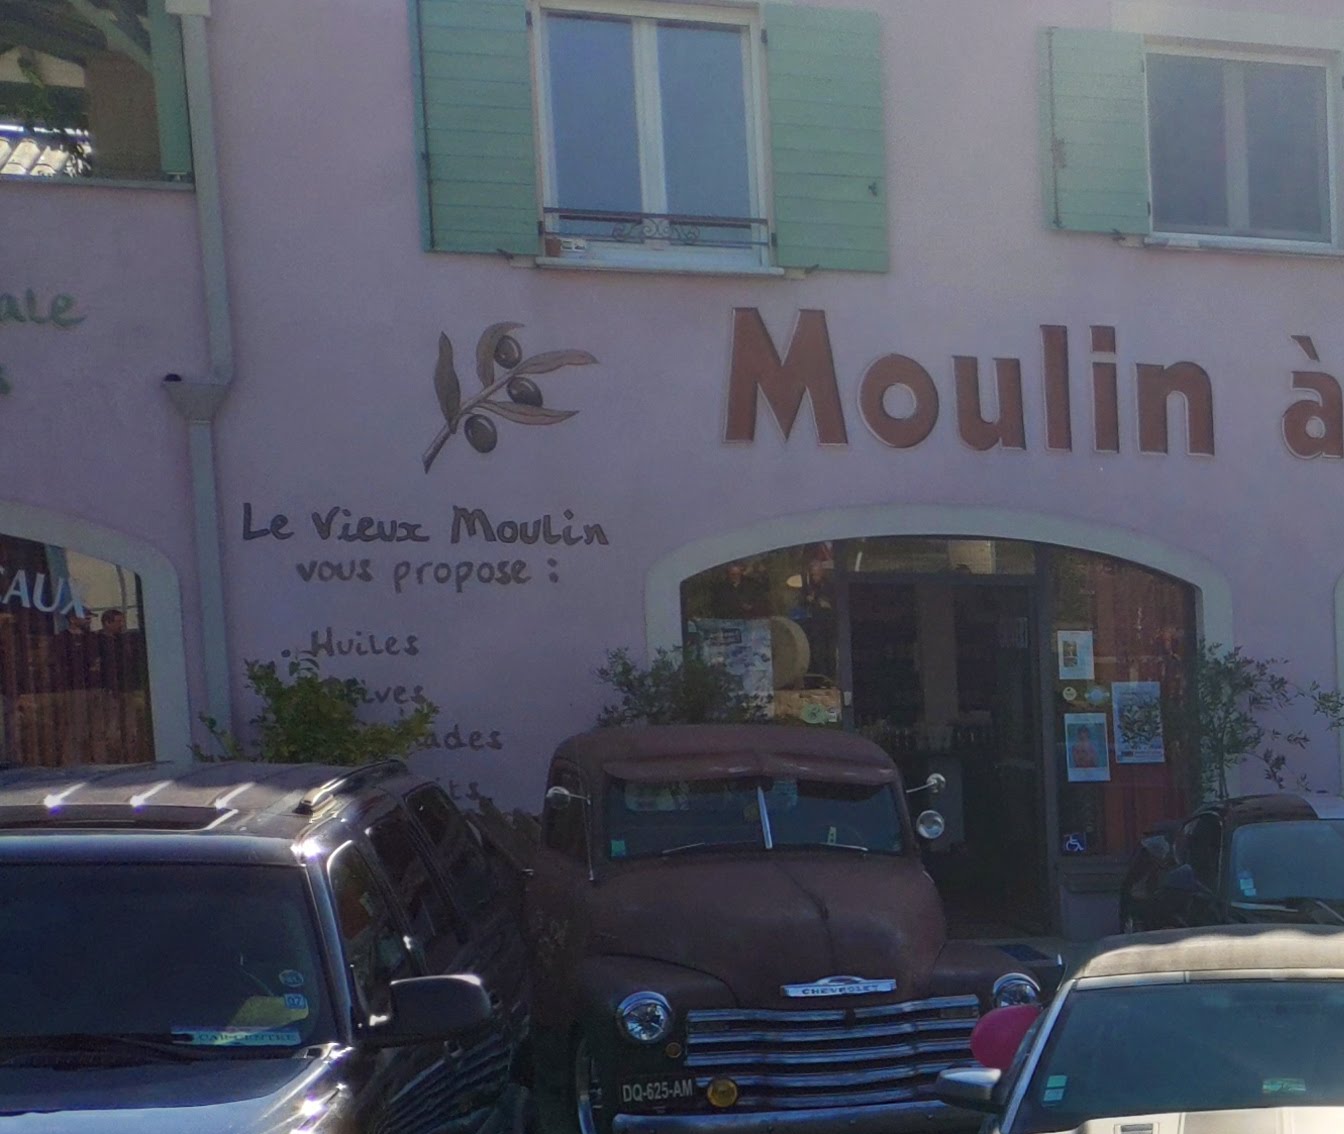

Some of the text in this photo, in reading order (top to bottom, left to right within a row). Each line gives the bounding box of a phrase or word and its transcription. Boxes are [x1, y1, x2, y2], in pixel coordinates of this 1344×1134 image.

[722, 306, 1215, 456] Moulin
[1281, 334, 1344, 460] à
[242, 502, 610, 546] Le Vieux Moulin
[0, 566, 85, 619] AUX
[296, 557, 374, 584] vous
[393, 558, 532, 594] propose
[310, 626, 420, 657] Huiles
[801, 984, 880, 996] CHEVROLET
[622, 1079, 694, 1102] DQ-625-AM
